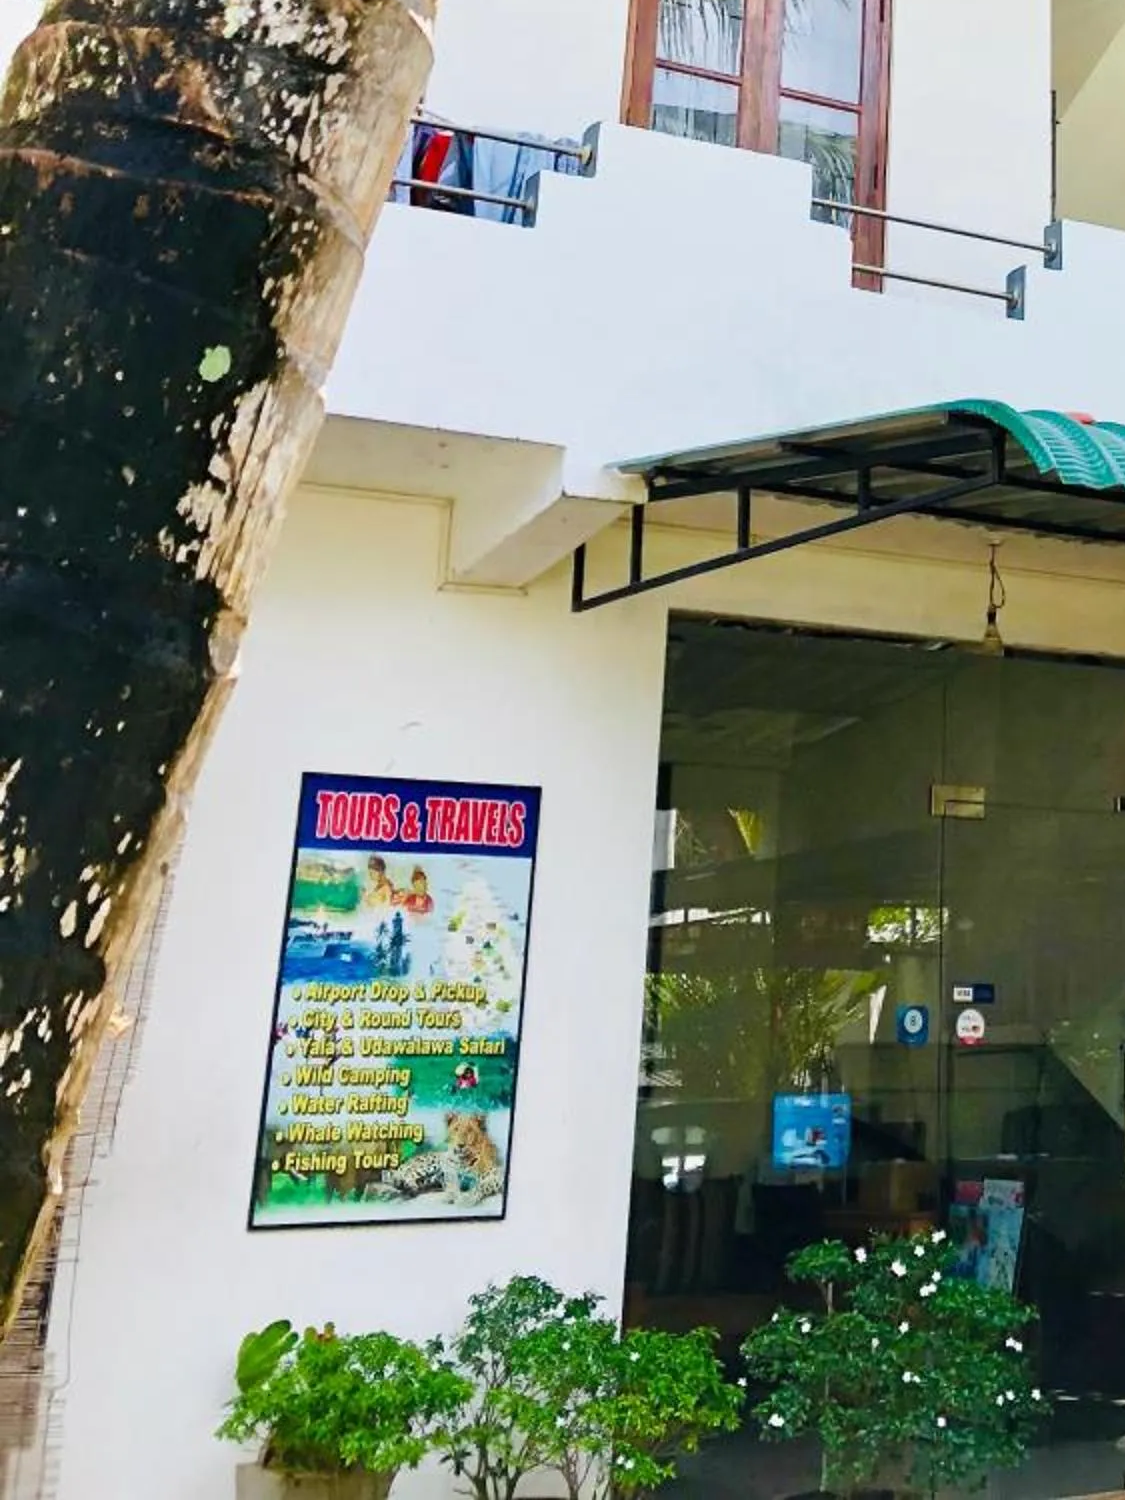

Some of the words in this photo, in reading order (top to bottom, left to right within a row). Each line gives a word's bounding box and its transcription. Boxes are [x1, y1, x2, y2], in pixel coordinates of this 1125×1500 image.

[316, 790, 400, 841] TOURS
[402, 803, 421, 842] &
[426, 797, 526, 847] TRAVELS
[305, 982, 365, 1005] Airport
[370, 982, 408, 1003] Drop
[414, 984, 426, 1000] &
[432, 983, 487, 1004] Pickup
[302, 1010, 336, 1031] City
[341, 1011, 354, 1028] &
[360, 1010, 412, 1028] Round
[416, 1011, 463, 1028] Tours
[300, 1038, 337, 1057] Yala
[341, 1038, 354, 1056] &
[459, 1038, 506, 1056] Safari
[294, 1067, 332, 1086] Wild
[339, 1066, 411, 1088] Camping
[291, 1095, 343, 1115] Water
[349, 1094, 409, 1116] Rafting
[287, 1124, 341, 1144] Whale
[347, 1123, 425, 1143] Watching
[284, 1152, 347, 1174] Fishing
[353, 1151, 400, 1170] Tours
